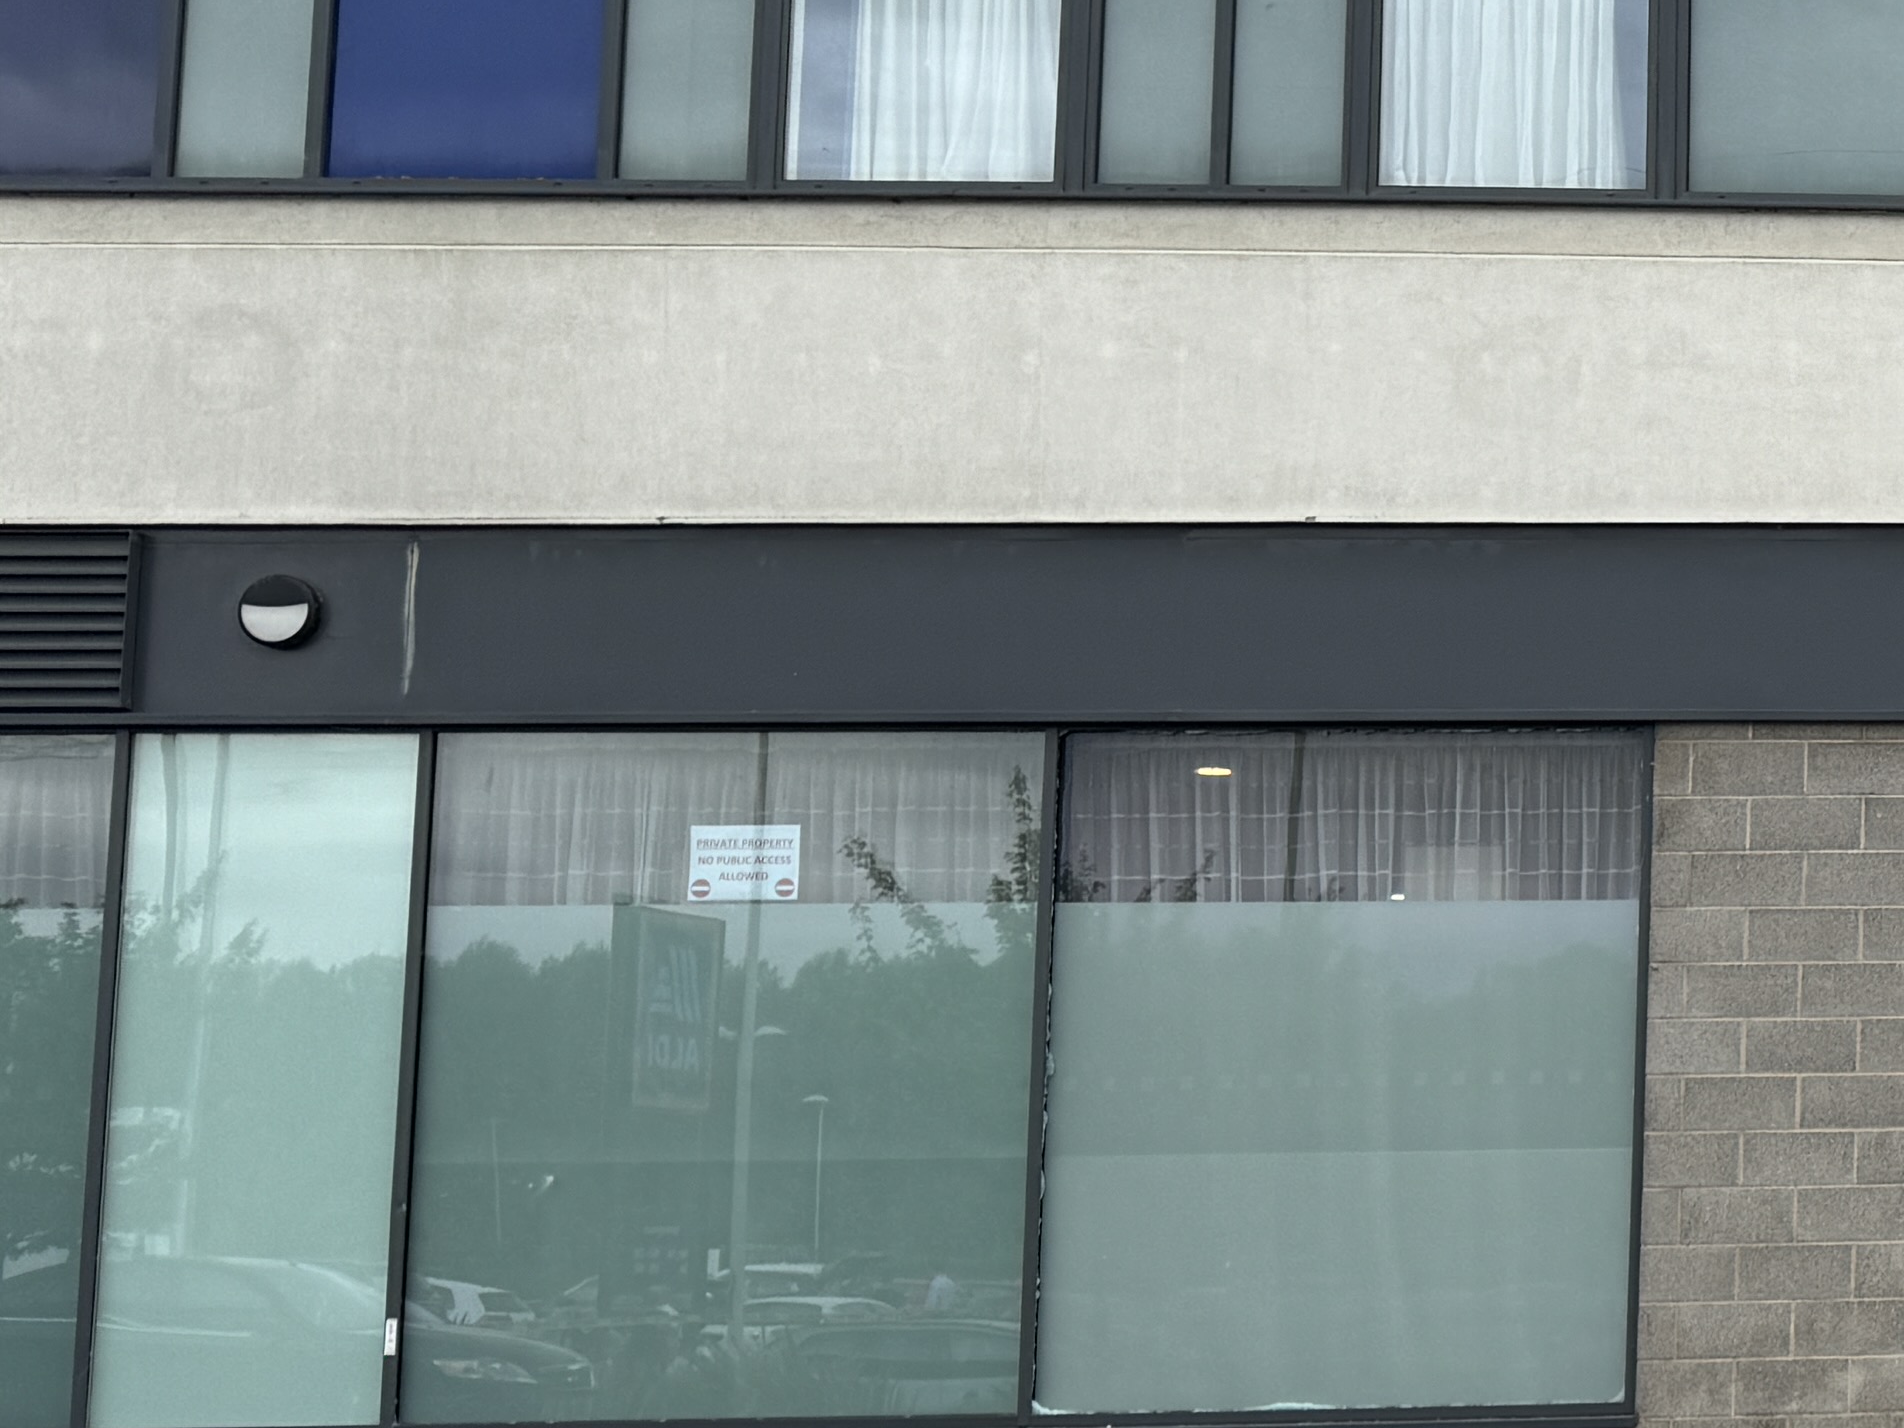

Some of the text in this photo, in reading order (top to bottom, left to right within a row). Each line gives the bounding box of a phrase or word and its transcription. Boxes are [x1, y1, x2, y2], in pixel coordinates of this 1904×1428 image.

[697, 838, 794, 850] PRIVATE PROPERTY
[698, 855, 792, 865] NO PUBLIC ACCESS
[719, 871, 768, 881] ALLOWED
